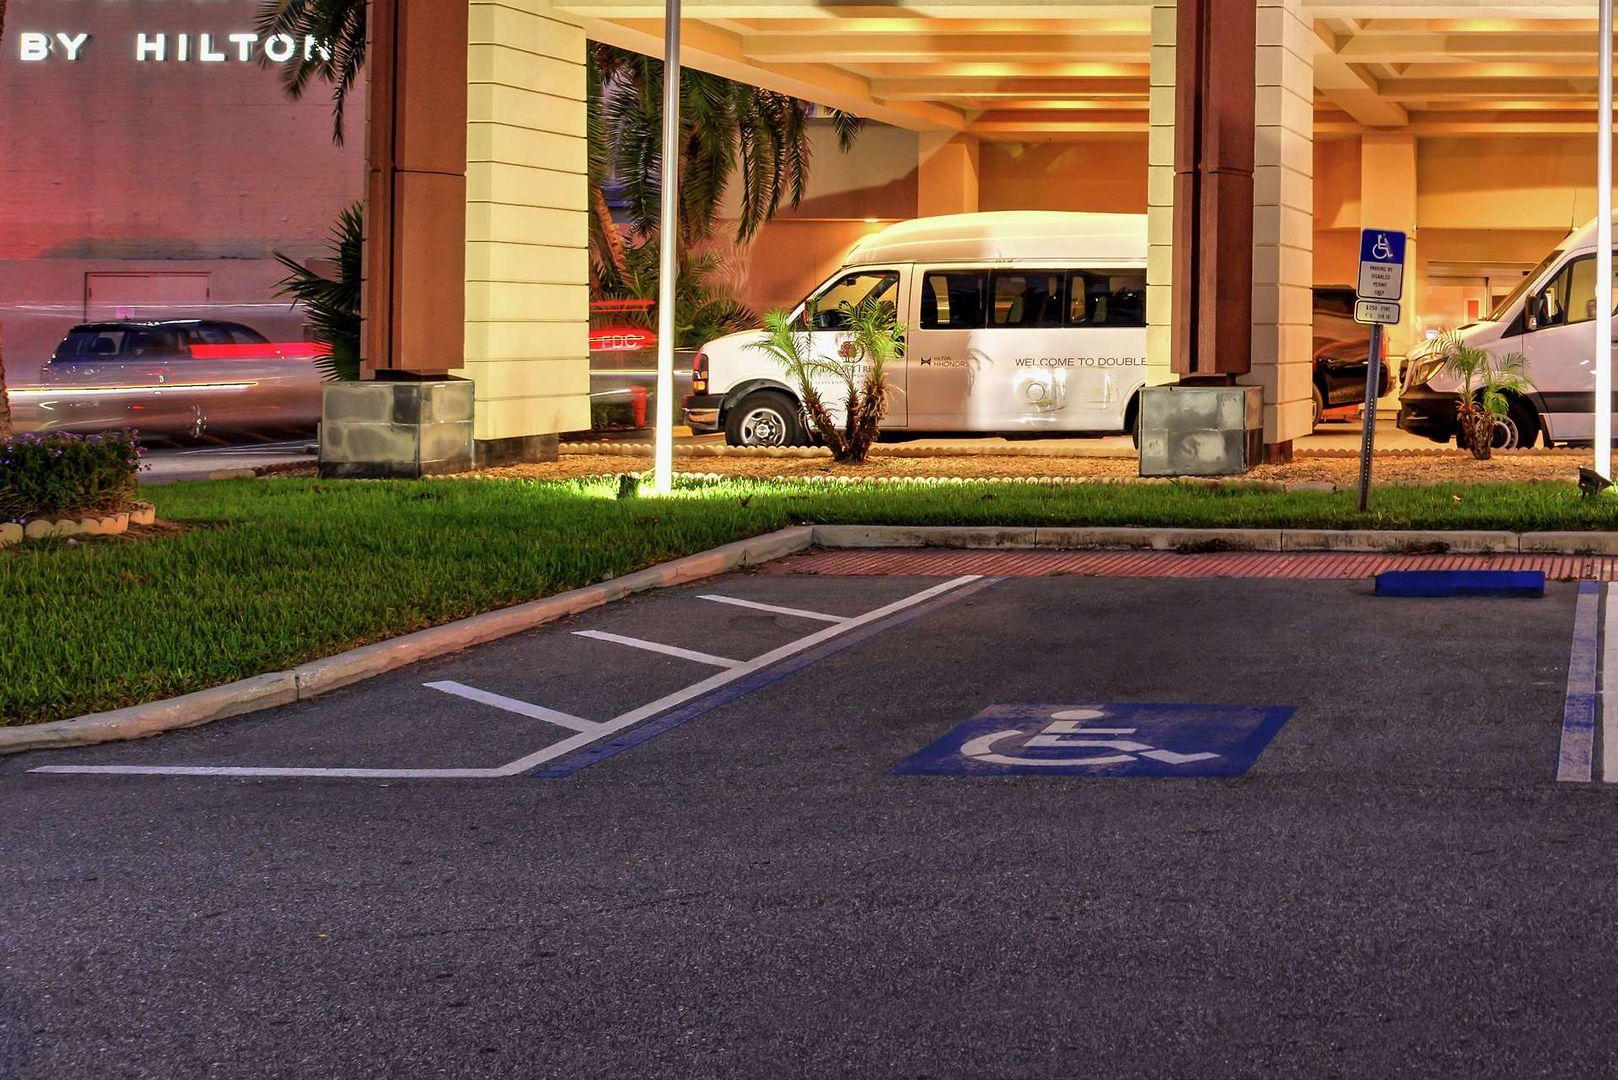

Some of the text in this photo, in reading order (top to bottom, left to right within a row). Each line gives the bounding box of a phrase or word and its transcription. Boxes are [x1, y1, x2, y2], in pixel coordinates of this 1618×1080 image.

[20, 32, 88, 61] BY
[1015, 357, 1147, 367] WELCOME TO DOUBLE
